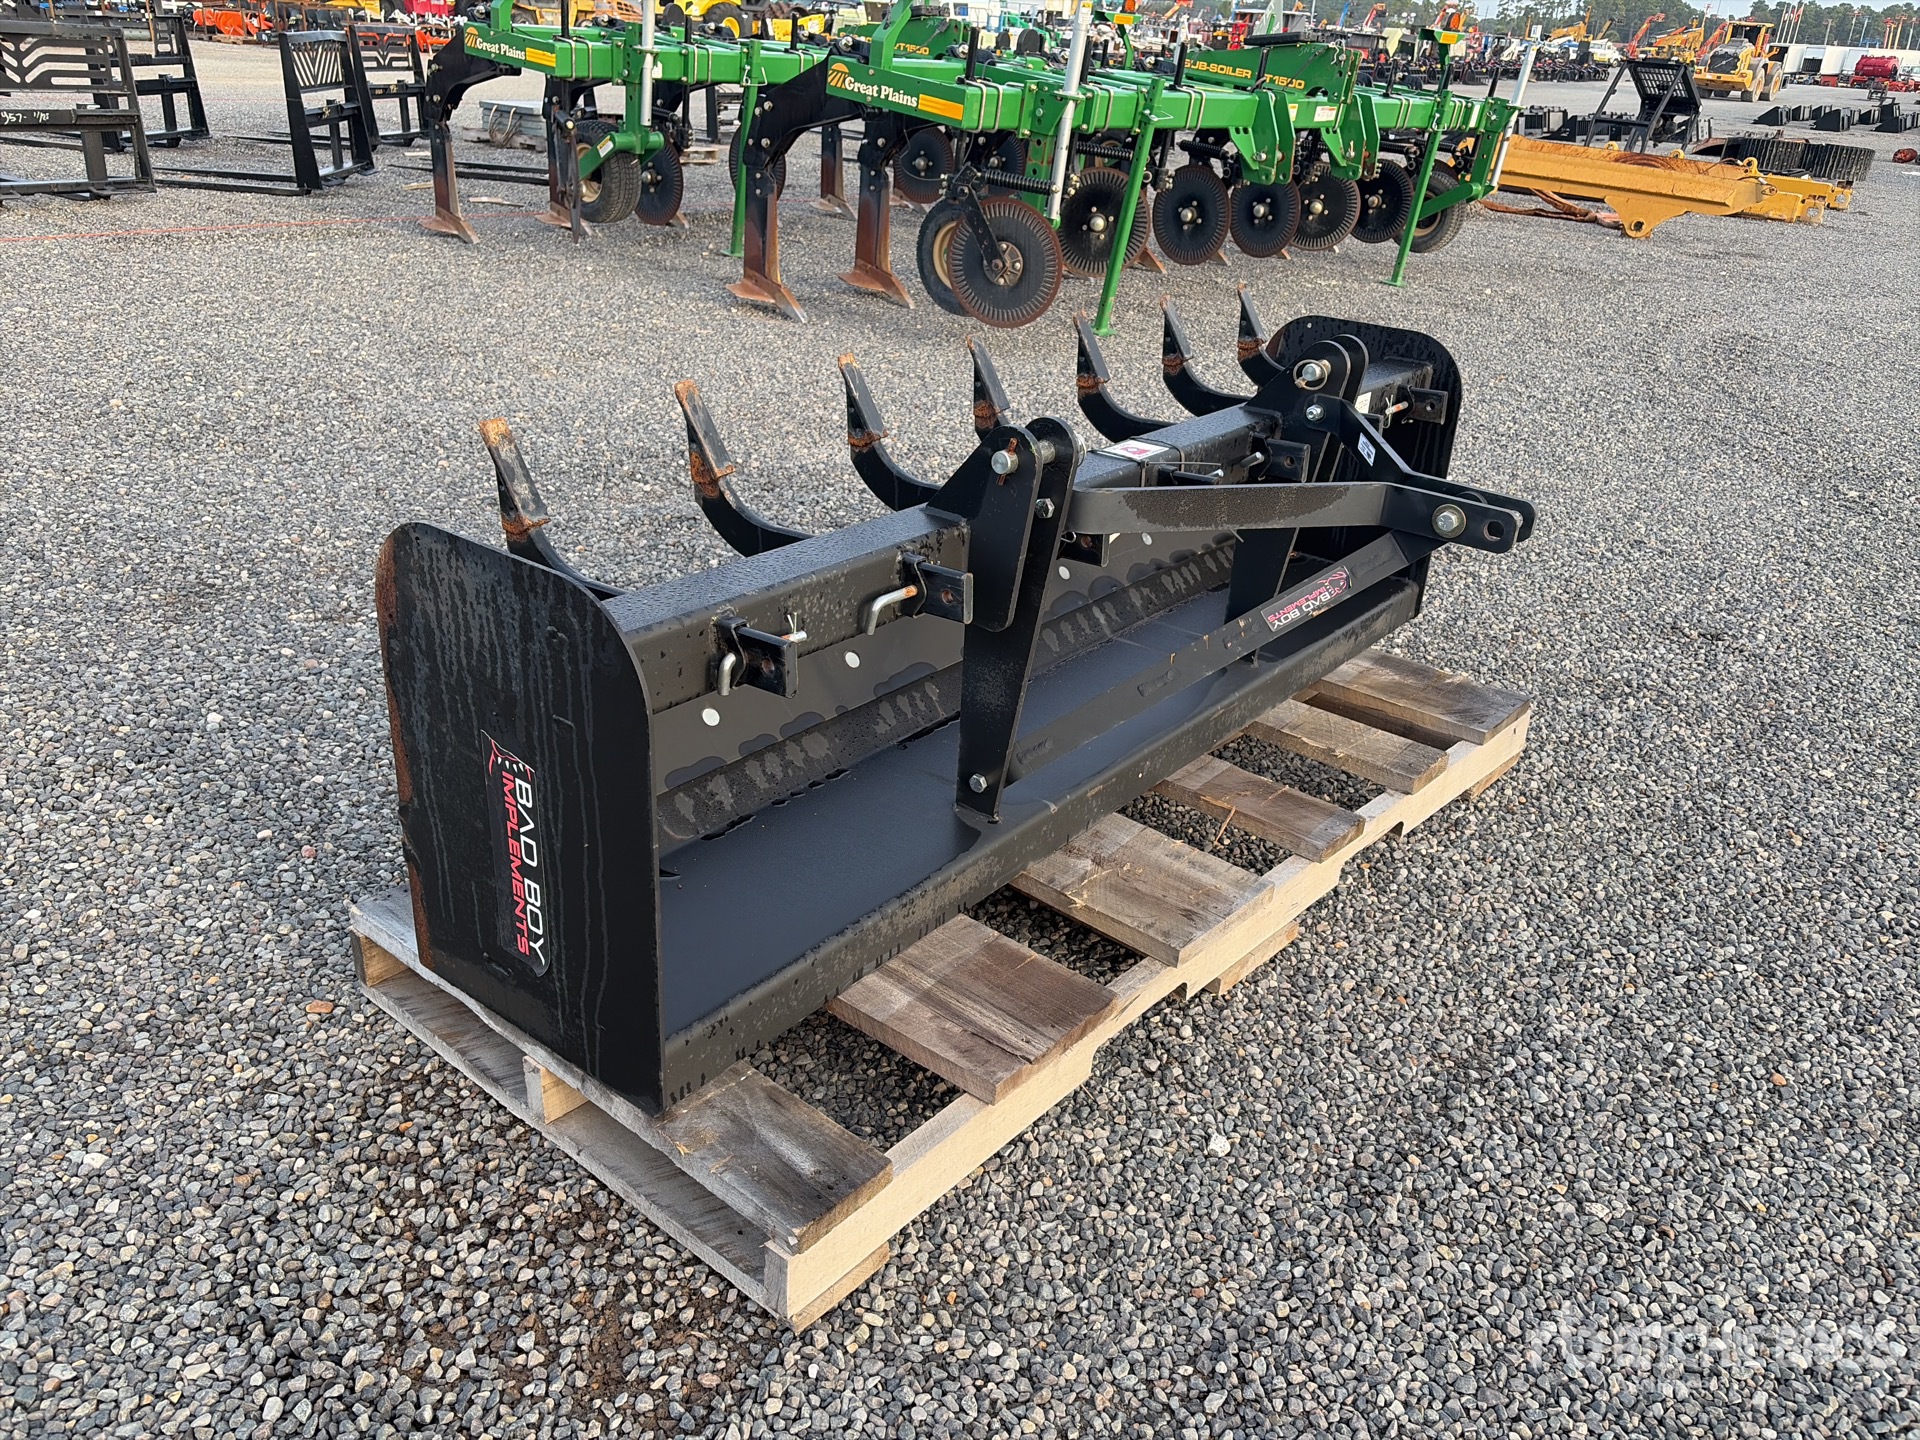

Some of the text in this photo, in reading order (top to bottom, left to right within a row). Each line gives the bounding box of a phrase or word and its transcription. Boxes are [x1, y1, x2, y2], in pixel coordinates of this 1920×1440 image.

[476, 38, 526, 60] Great Plains
[1184, 58, 1252, 79] SUB-SOILER
[844, 77, 918, 108] Great Plains
[1267, 586, 1326, 622] IMPLEMENTS
[1273, 592, 1331, 630] BAD BOY
[501, 769, 530, 956] IMPLEMENTS
[514, 778, 546, 967] BAD BOY
